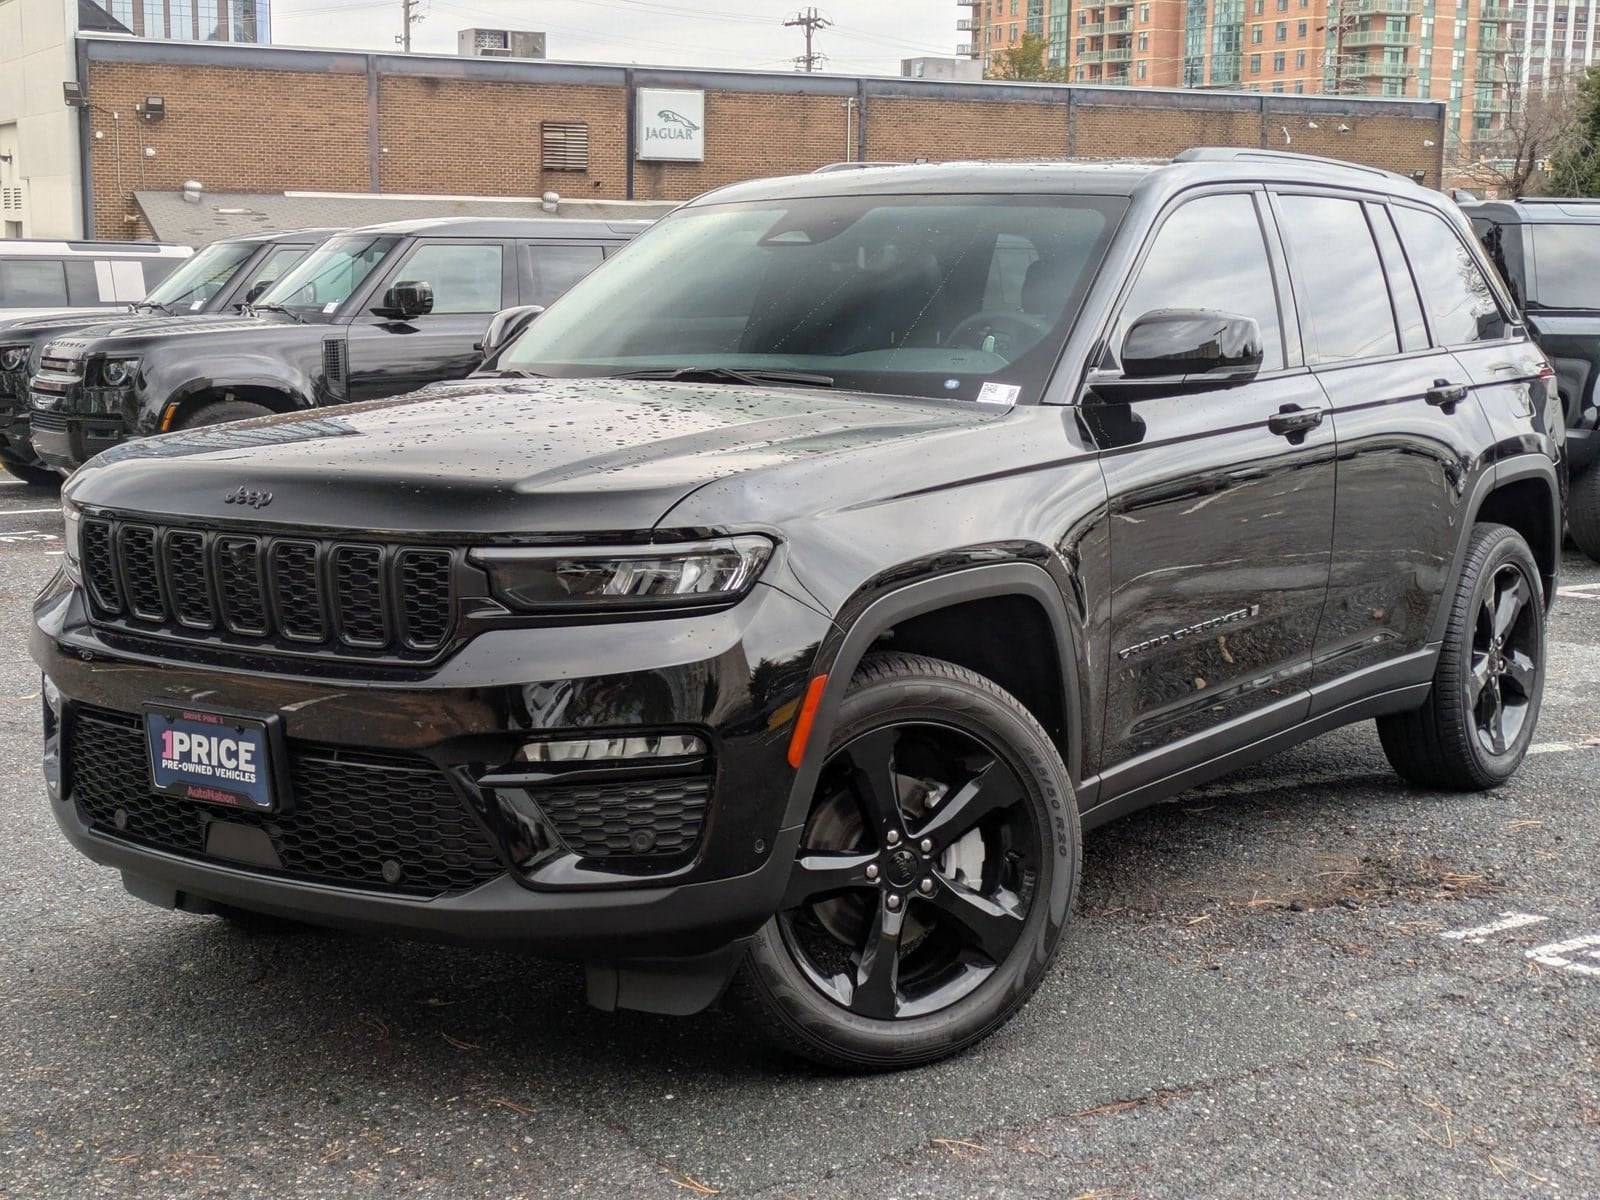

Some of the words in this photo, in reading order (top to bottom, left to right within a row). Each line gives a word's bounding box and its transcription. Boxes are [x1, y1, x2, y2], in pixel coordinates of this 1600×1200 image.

[645, 127, 693, 141] JAGUAR
[224, 485, 273, 510] Jeep
[161, 729, 256, 773] 1PRICE
[161, 759, 213, 776] PRE-OWNED
[215, 767, 256, 783] VEHICLES
[1055, 816, 1068, 858] R20
